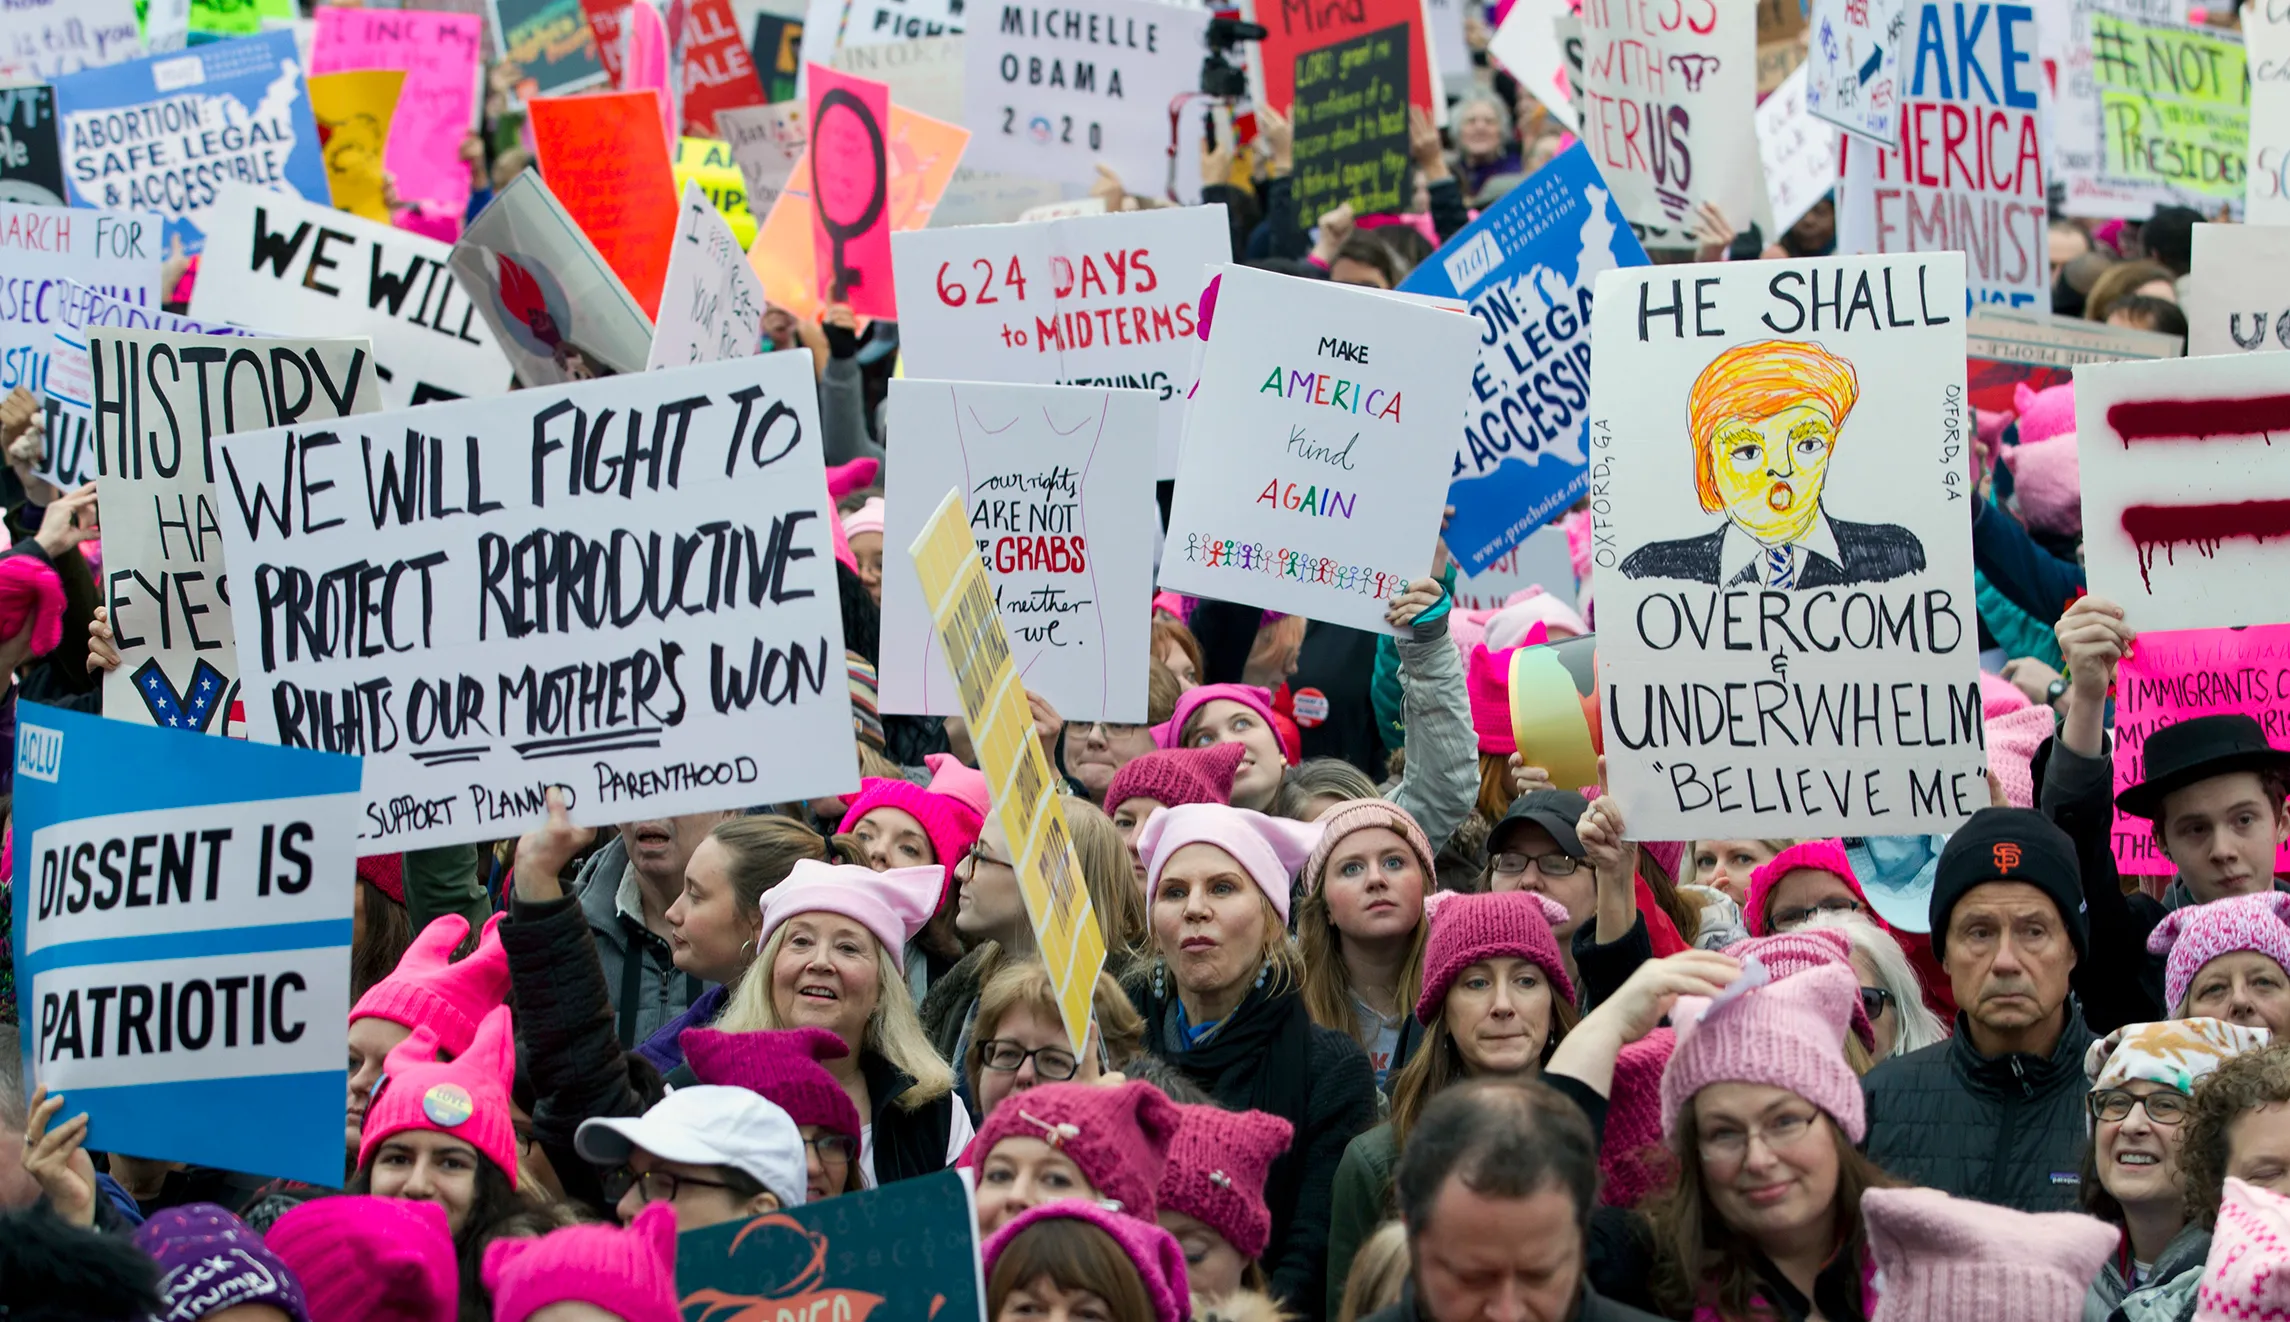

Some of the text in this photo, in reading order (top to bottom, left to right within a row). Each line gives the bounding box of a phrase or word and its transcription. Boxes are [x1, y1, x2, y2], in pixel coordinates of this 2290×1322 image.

[1001, 6, 1158, 53] MICHELLE
[1001, 53, 1125, 100] OBAMA
[1836, 75, 1859, 111] HER
[73, 98, 211, 154] ABORTION:
[183, 118, 291, 160] LEGAL
[103, 150, 280, 213] & ACCESSIBLE
[1491, 171, 1562, 232] NATIONAL
[95, 216, 147, 259] FOR
[1500, 184, 1570, 245] ABORTION
[1505, 198, 1577, 258] FEDERATION
[251, 206, 482, 346] WE WILL
[936, 248, 1158, 308] 624 DAYS
[1638, 276, 1726, 342] HE
[1762, 265, 1951, 334] SHALL
[1001, 302, 1197, 354] to MIDTERMS
[1317, 336, 1370, 365] MAKE
[1503, 285, 1594, 376] LEGA
[90, 336, 367, 482] HISTORY
[1259, 366, 1402, 424] AMERICA
[1465, 341, 1592, 473] ACCESSIB
[221, 384, 803, 542] WE WILL FIGHT TO
[1286, 423, 1360, 471] Kind
[1943, 384, 1962, 503] OXFORD, GA
[973, 465, 1080, 503] our rights
[1256, 477, 1357, 520] AGAIN
[1593, 418, 1617, 569] OXFORD, GA
[154, 494, 223, 562] HA
[970, 499, 1078, 534] ARE NOT
[1471, 471, 1590, 565] www.prochoice.org
[995, 535, 1086, 574] GRABS
[254, 510, 819, 673] PROTECT REPRODUCTIVE
[1006, 584, 1092, 614] neither
[1014, 619, 1084, 648] we.
[1635, 589, 1962, 655] OVERCOMB
[1770, 645, 1789, 685] &
[2127, 667, 2273, 714] IMMIGRANTS,
[271, 675, 400, 755] RIGHTS
[406, 674, 496, 745] OUR
[710, 636, 829, 716] WON
[1609, 680, 1986, 751] UNDERWHELM
[19, 733, 60, 776] ACLU
[469, 780, 577, 824] PLANND
[593, 755, 759, 803] PARENTHOOD
[1652, 759, 1990, 821] "BELIEVE ME"
[38, 820, 315, 921] DISSENT IS
[1992, 842, 2022, 875] SF
[39, 970, 307, 1064] PATRIOTIC
